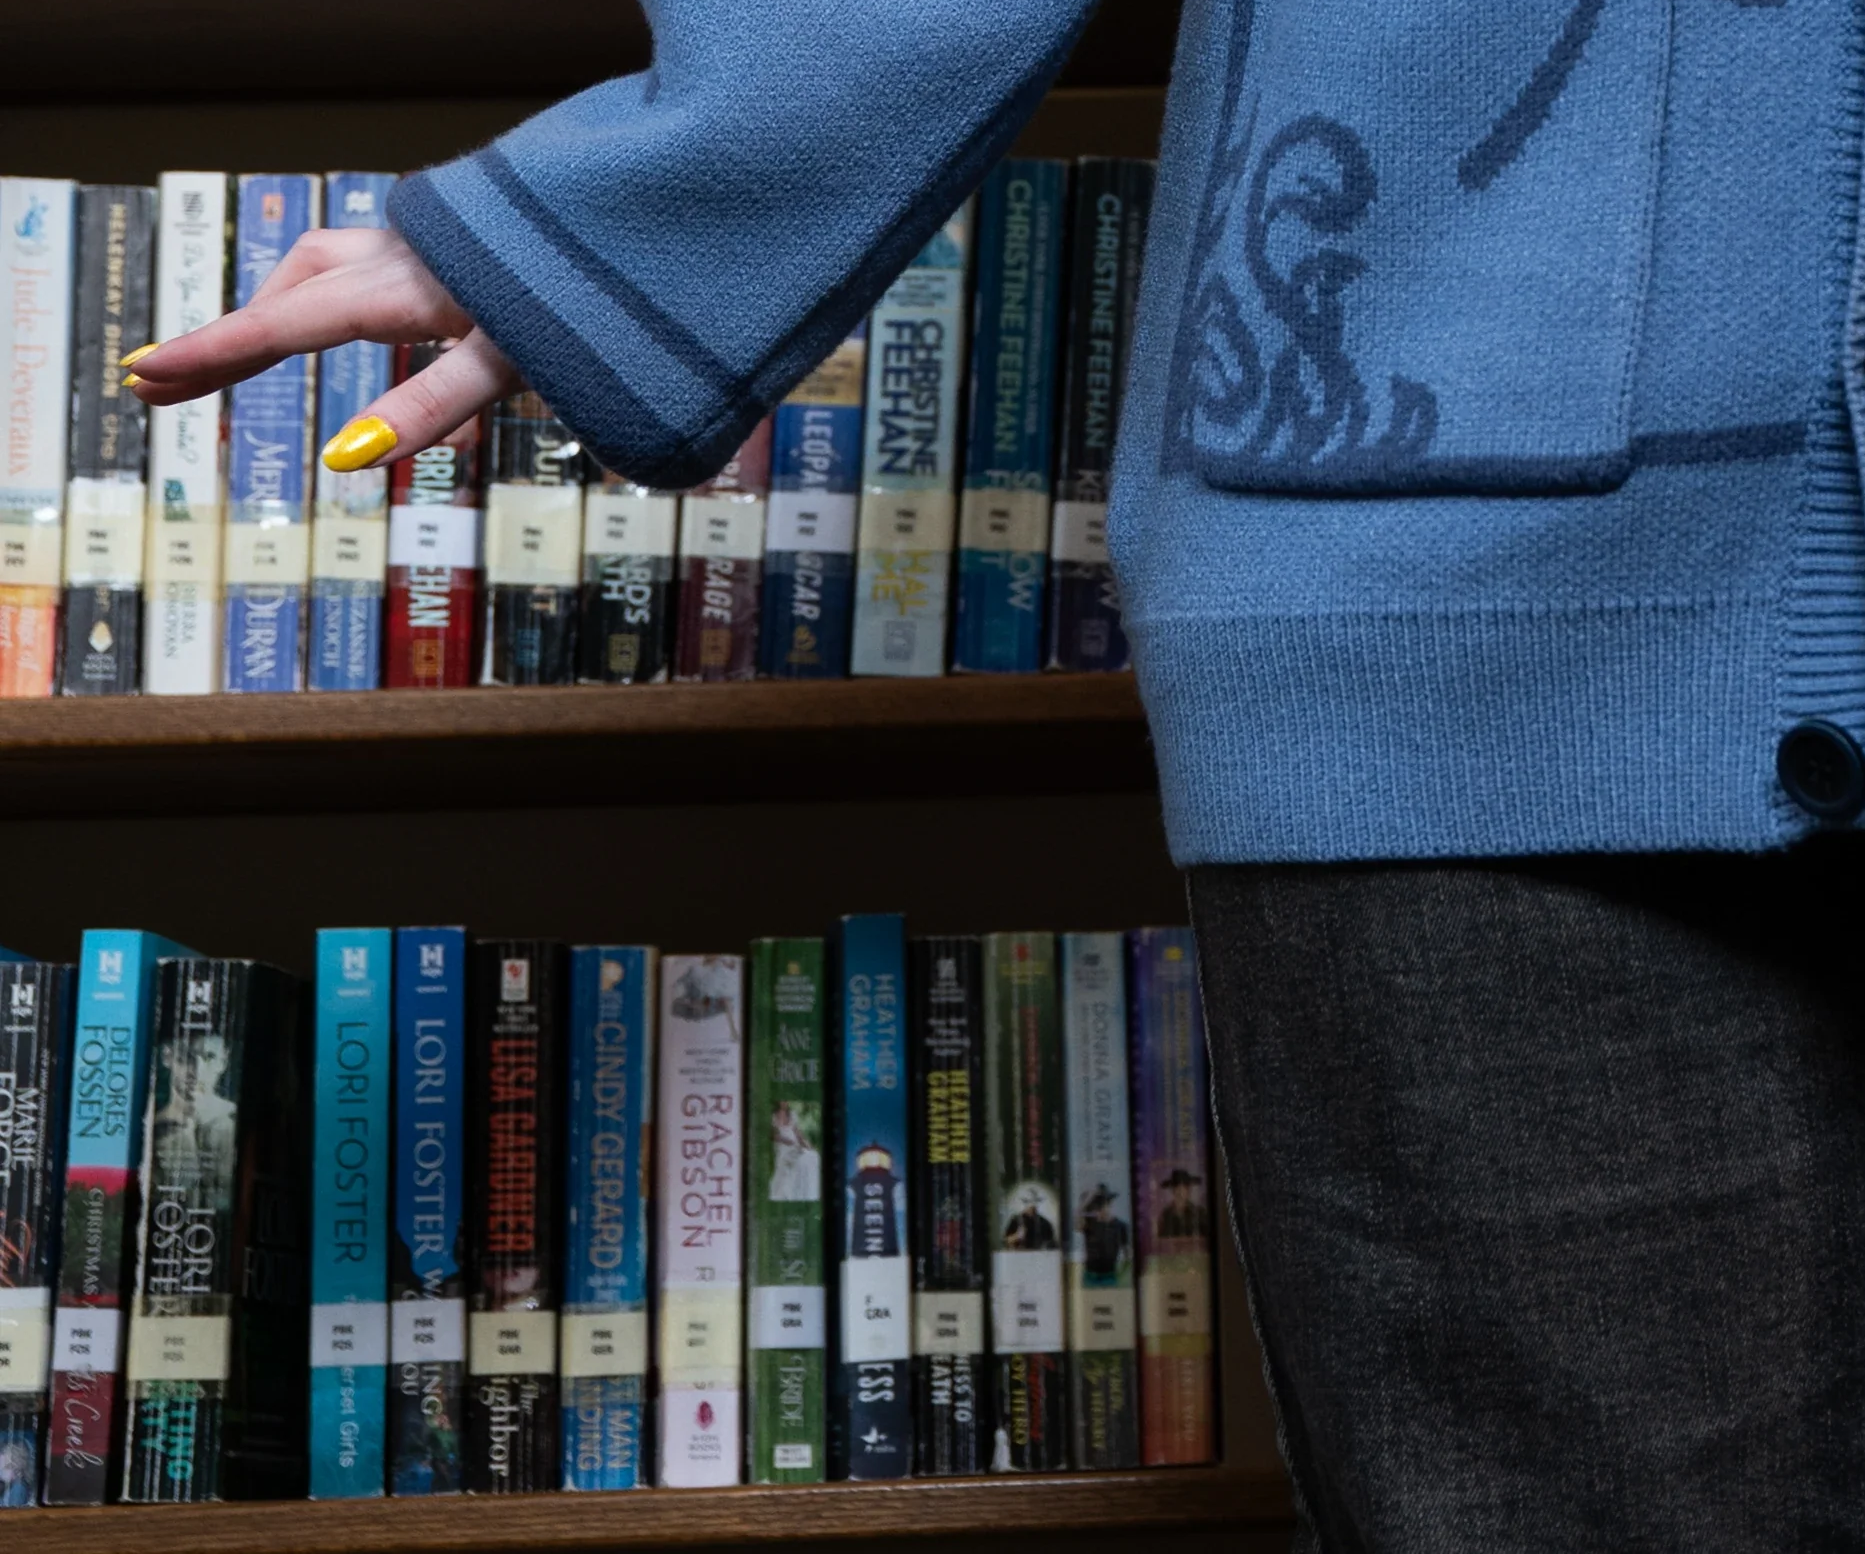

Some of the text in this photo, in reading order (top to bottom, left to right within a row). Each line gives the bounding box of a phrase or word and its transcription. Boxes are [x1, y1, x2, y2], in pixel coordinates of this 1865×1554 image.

[106, 203, 127, 315] HELENKAY
[10, 259, 50, 477] Jude Deveraux
[101, 323, 121, 398] DIMON
[994, 179, 1033, 453] CHRISTINE FEEHAN
[1082, 193, 1123, 448] CHRISTINE FEEHAN
[801, 410, 834, 494] LEOPA
[878, 319, 917, 476] FEEHAN
[912, 319, 944, 476] CHRISTINE
[406, 446, 455, 507] BRIA
[163, 581, 181, 660] ONOVAN
[242, 587, 288, 680] DURAN
[321, 594, 344, 669] ENOCH
[407, 564, 451, 628] EHAN
[702, 560, 733, 624] RAGE
[75, 1023, 107, 1140] FOSSEN
[103, 1025, 131, 1138] DELORES
[848, 974, 873, 1091] GRAHAM
[874, 974, 898, 1090] HEATHER
[13, 1086, 42, 1171] MARIE
[332, 1020, 370, 1264] LORI FOSTER
[411, 1018, 447, 1260] LORI FOSTER
[486, 1040, 538, 1252] LISA GARDNER
[586, 1020, 626, 1269] CINDY GERARD
[705, 1094, 733, 1243] RACHEL
[927, 1069, 950, 1163] GRAHAM
[948, 1069, 971, 1163] HEATHER
[680, 1093, 707, 1249] GIBSON
[863, 1182, 885, 1258] SEEIN
[81, 1186, 104, 1295] CHRISTMAS
[149, 1184, 189, 1315] FOSTER
[183, 1206, 216, 1294] LORI
[64, 1398, 104, 1469] Creek
[337, 1367, 361, 1466] erset Girls
[480, 1376, 521, 1478] ighbor
[930, 1353, 954, 1405] EATH
